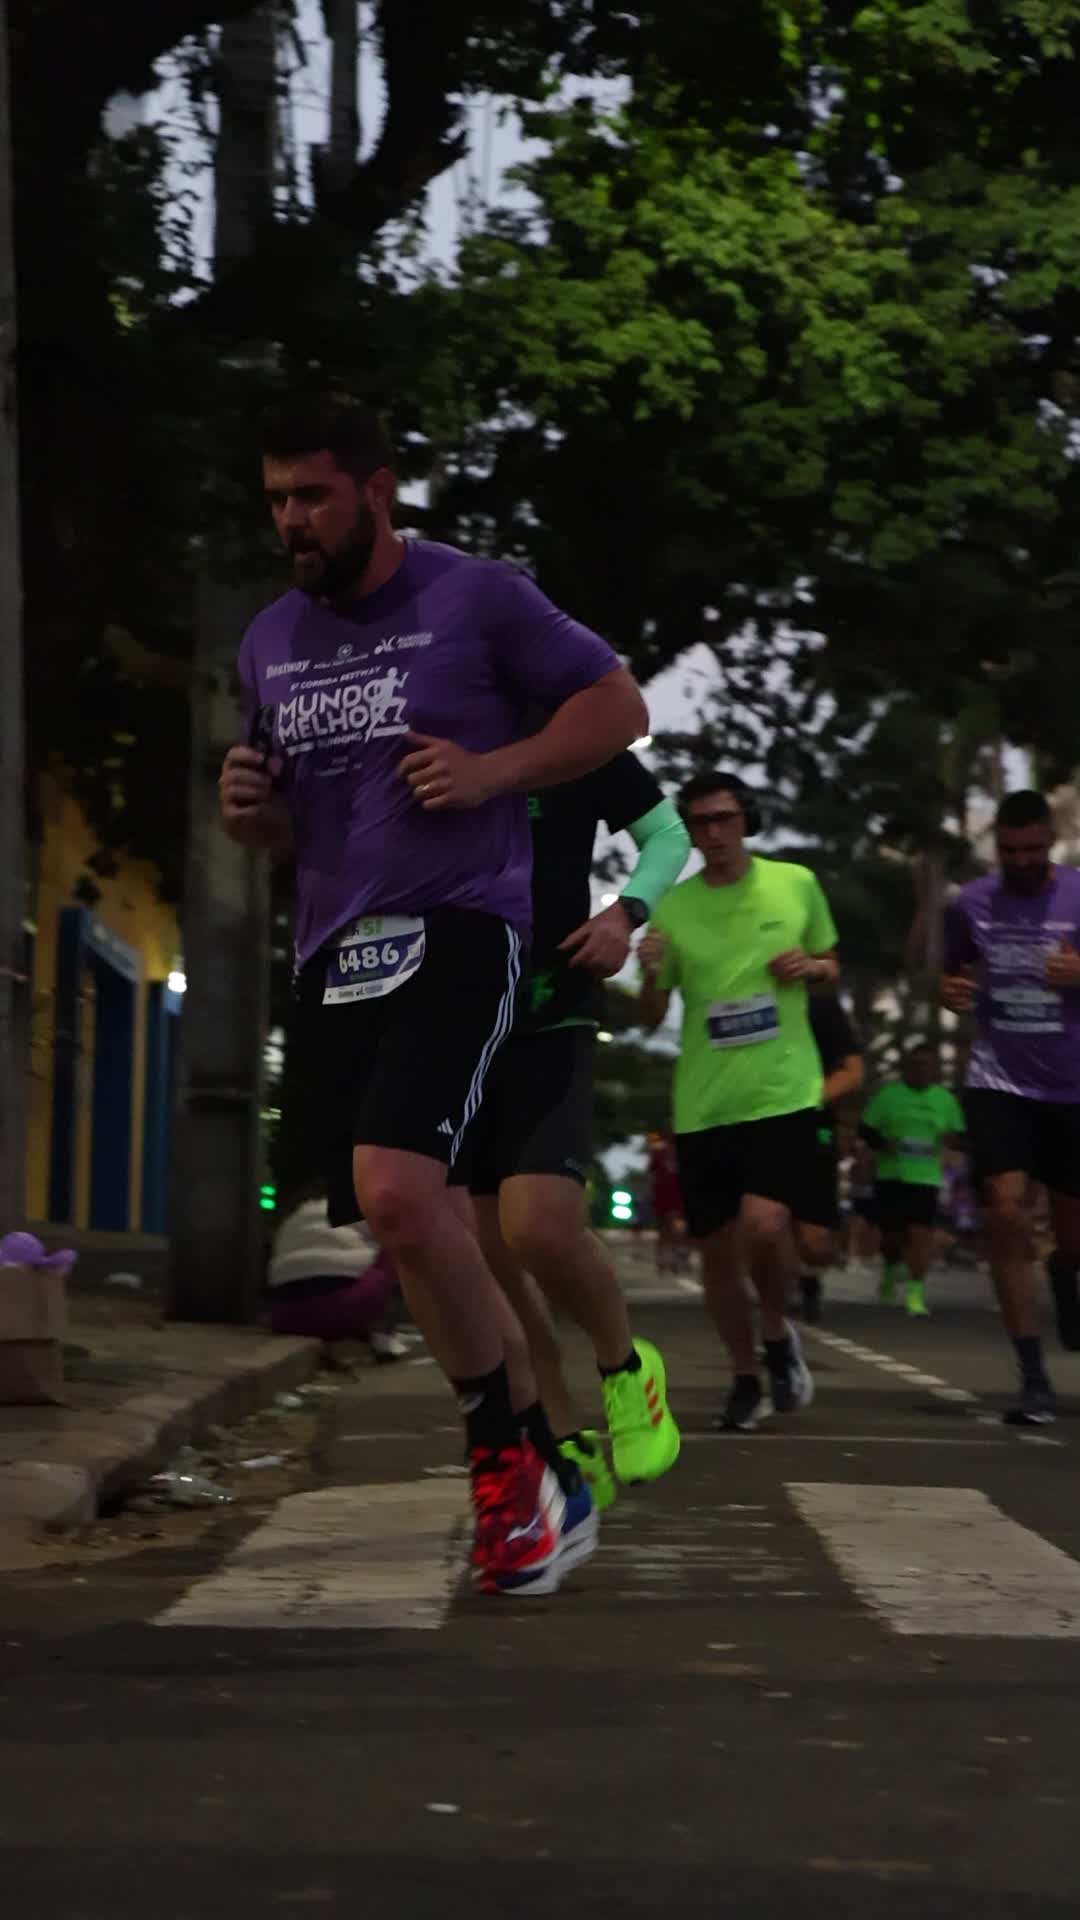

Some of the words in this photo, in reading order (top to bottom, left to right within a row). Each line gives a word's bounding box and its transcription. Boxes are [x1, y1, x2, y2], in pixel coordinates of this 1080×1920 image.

[300, 677, 338, 690] CORRIDA
[339, 665, 381, 684] BESTWAY
[338, 941, 400, 975] 6486
